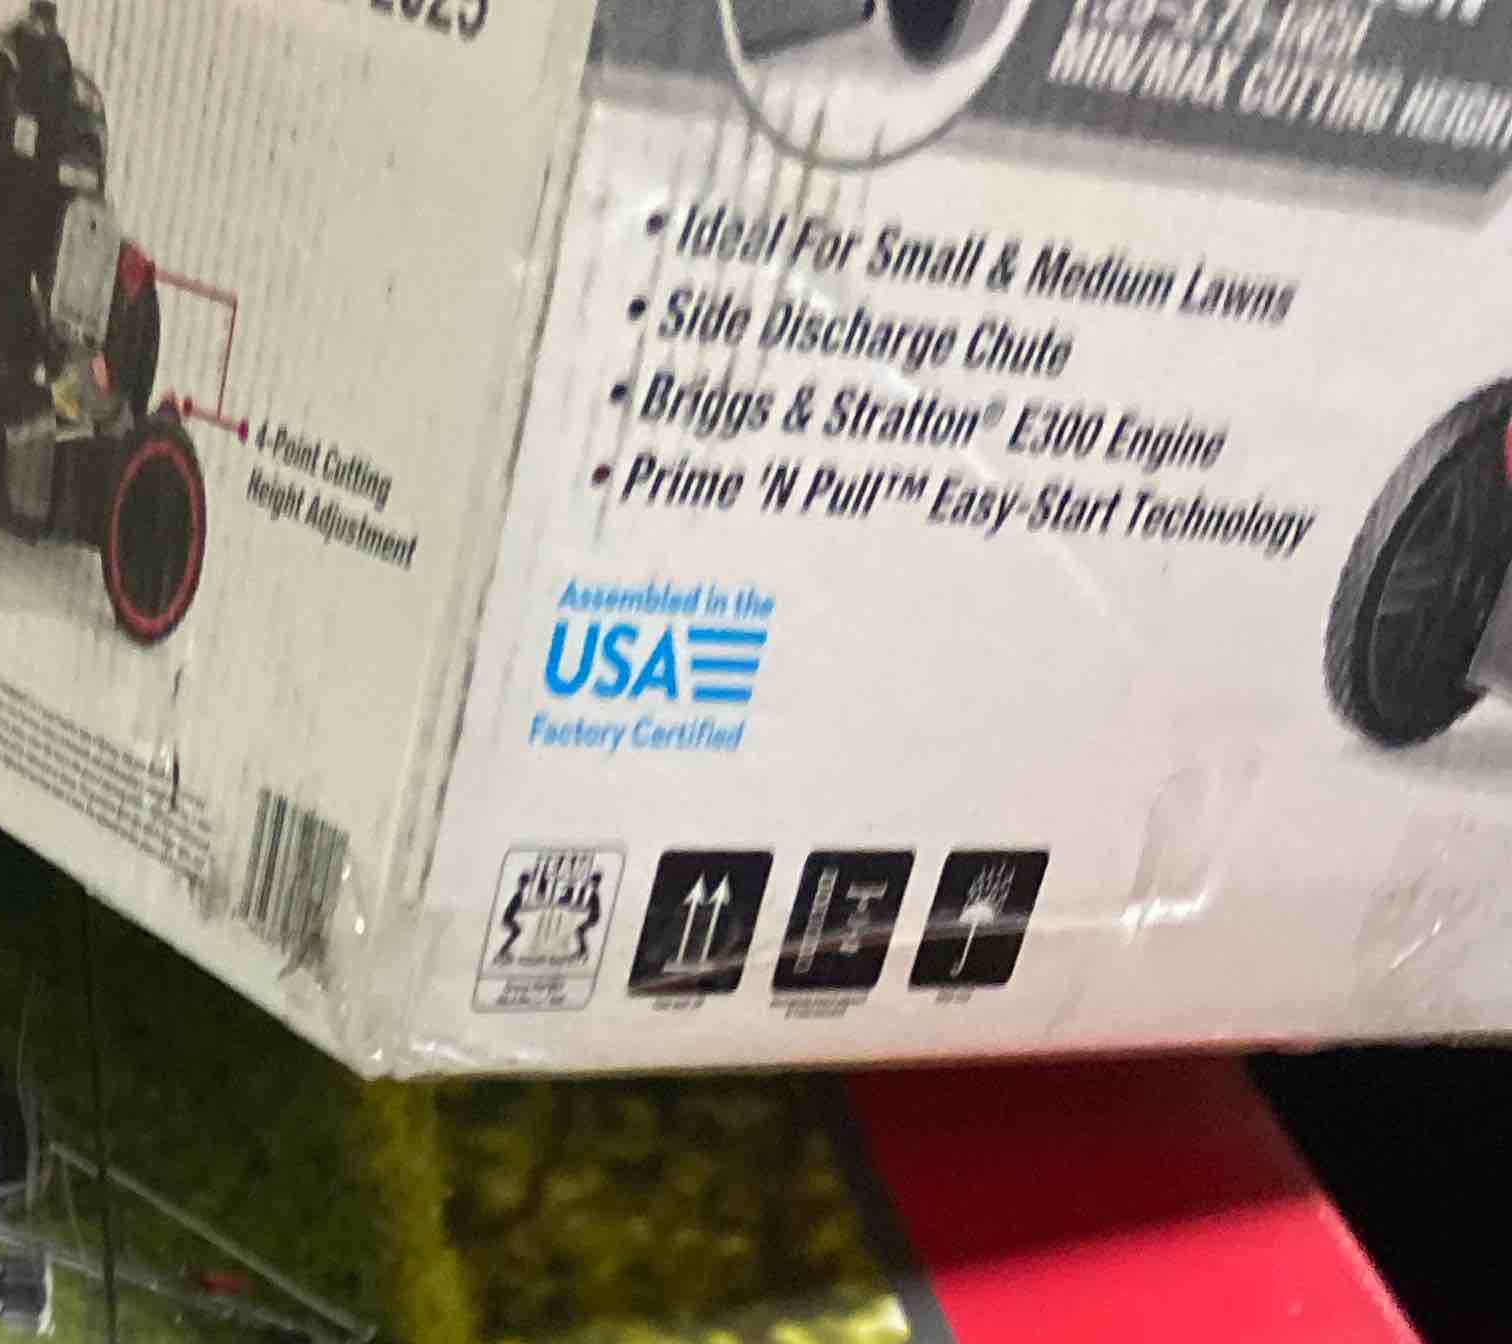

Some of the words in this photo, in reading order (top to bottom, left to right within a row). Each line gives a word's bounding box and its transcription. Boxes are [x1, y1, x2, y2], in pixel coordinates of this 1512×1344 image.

[676, 204, 788, 264] Ideal
[790, 218, 860, 274] For
[867, 228, 986, 288] Small
[986, 242, 1022, 288] &
[1026, 246, 1177, 306] Medium
[1179, 264, 1299, 327] Lawns
[659, 288, 749, 342] Side
[757, 299, 954, 374] Discharge
[962, 319, 1073, 378] Chute
[255, 419, 322, 477] 4-Point
[322, 444, 393, 512] Cutting
[639, 369, 773, 439] Briggs
[782, 388, 813, 433] &
[1008, 404, 1106, 459] E300
[1106, 414, 1227, 476] Engine
[246, 467, 306, 521] Height
[305, 494, 419, 570] Adjustment
[619, 451, 744, 510] Prime
[929, 476, 1120, 540] Easy-Start
[1126, 491, 1316, 559] Technology
[558, 580, 700, 617] Assembled
[704, 585, 728, 618] in
[734, 587, 775, 620] the
[542, 621, 679, 701] USA
[528, 713, 626, 754] Factory
[630, 716, 745, 752] Certified
